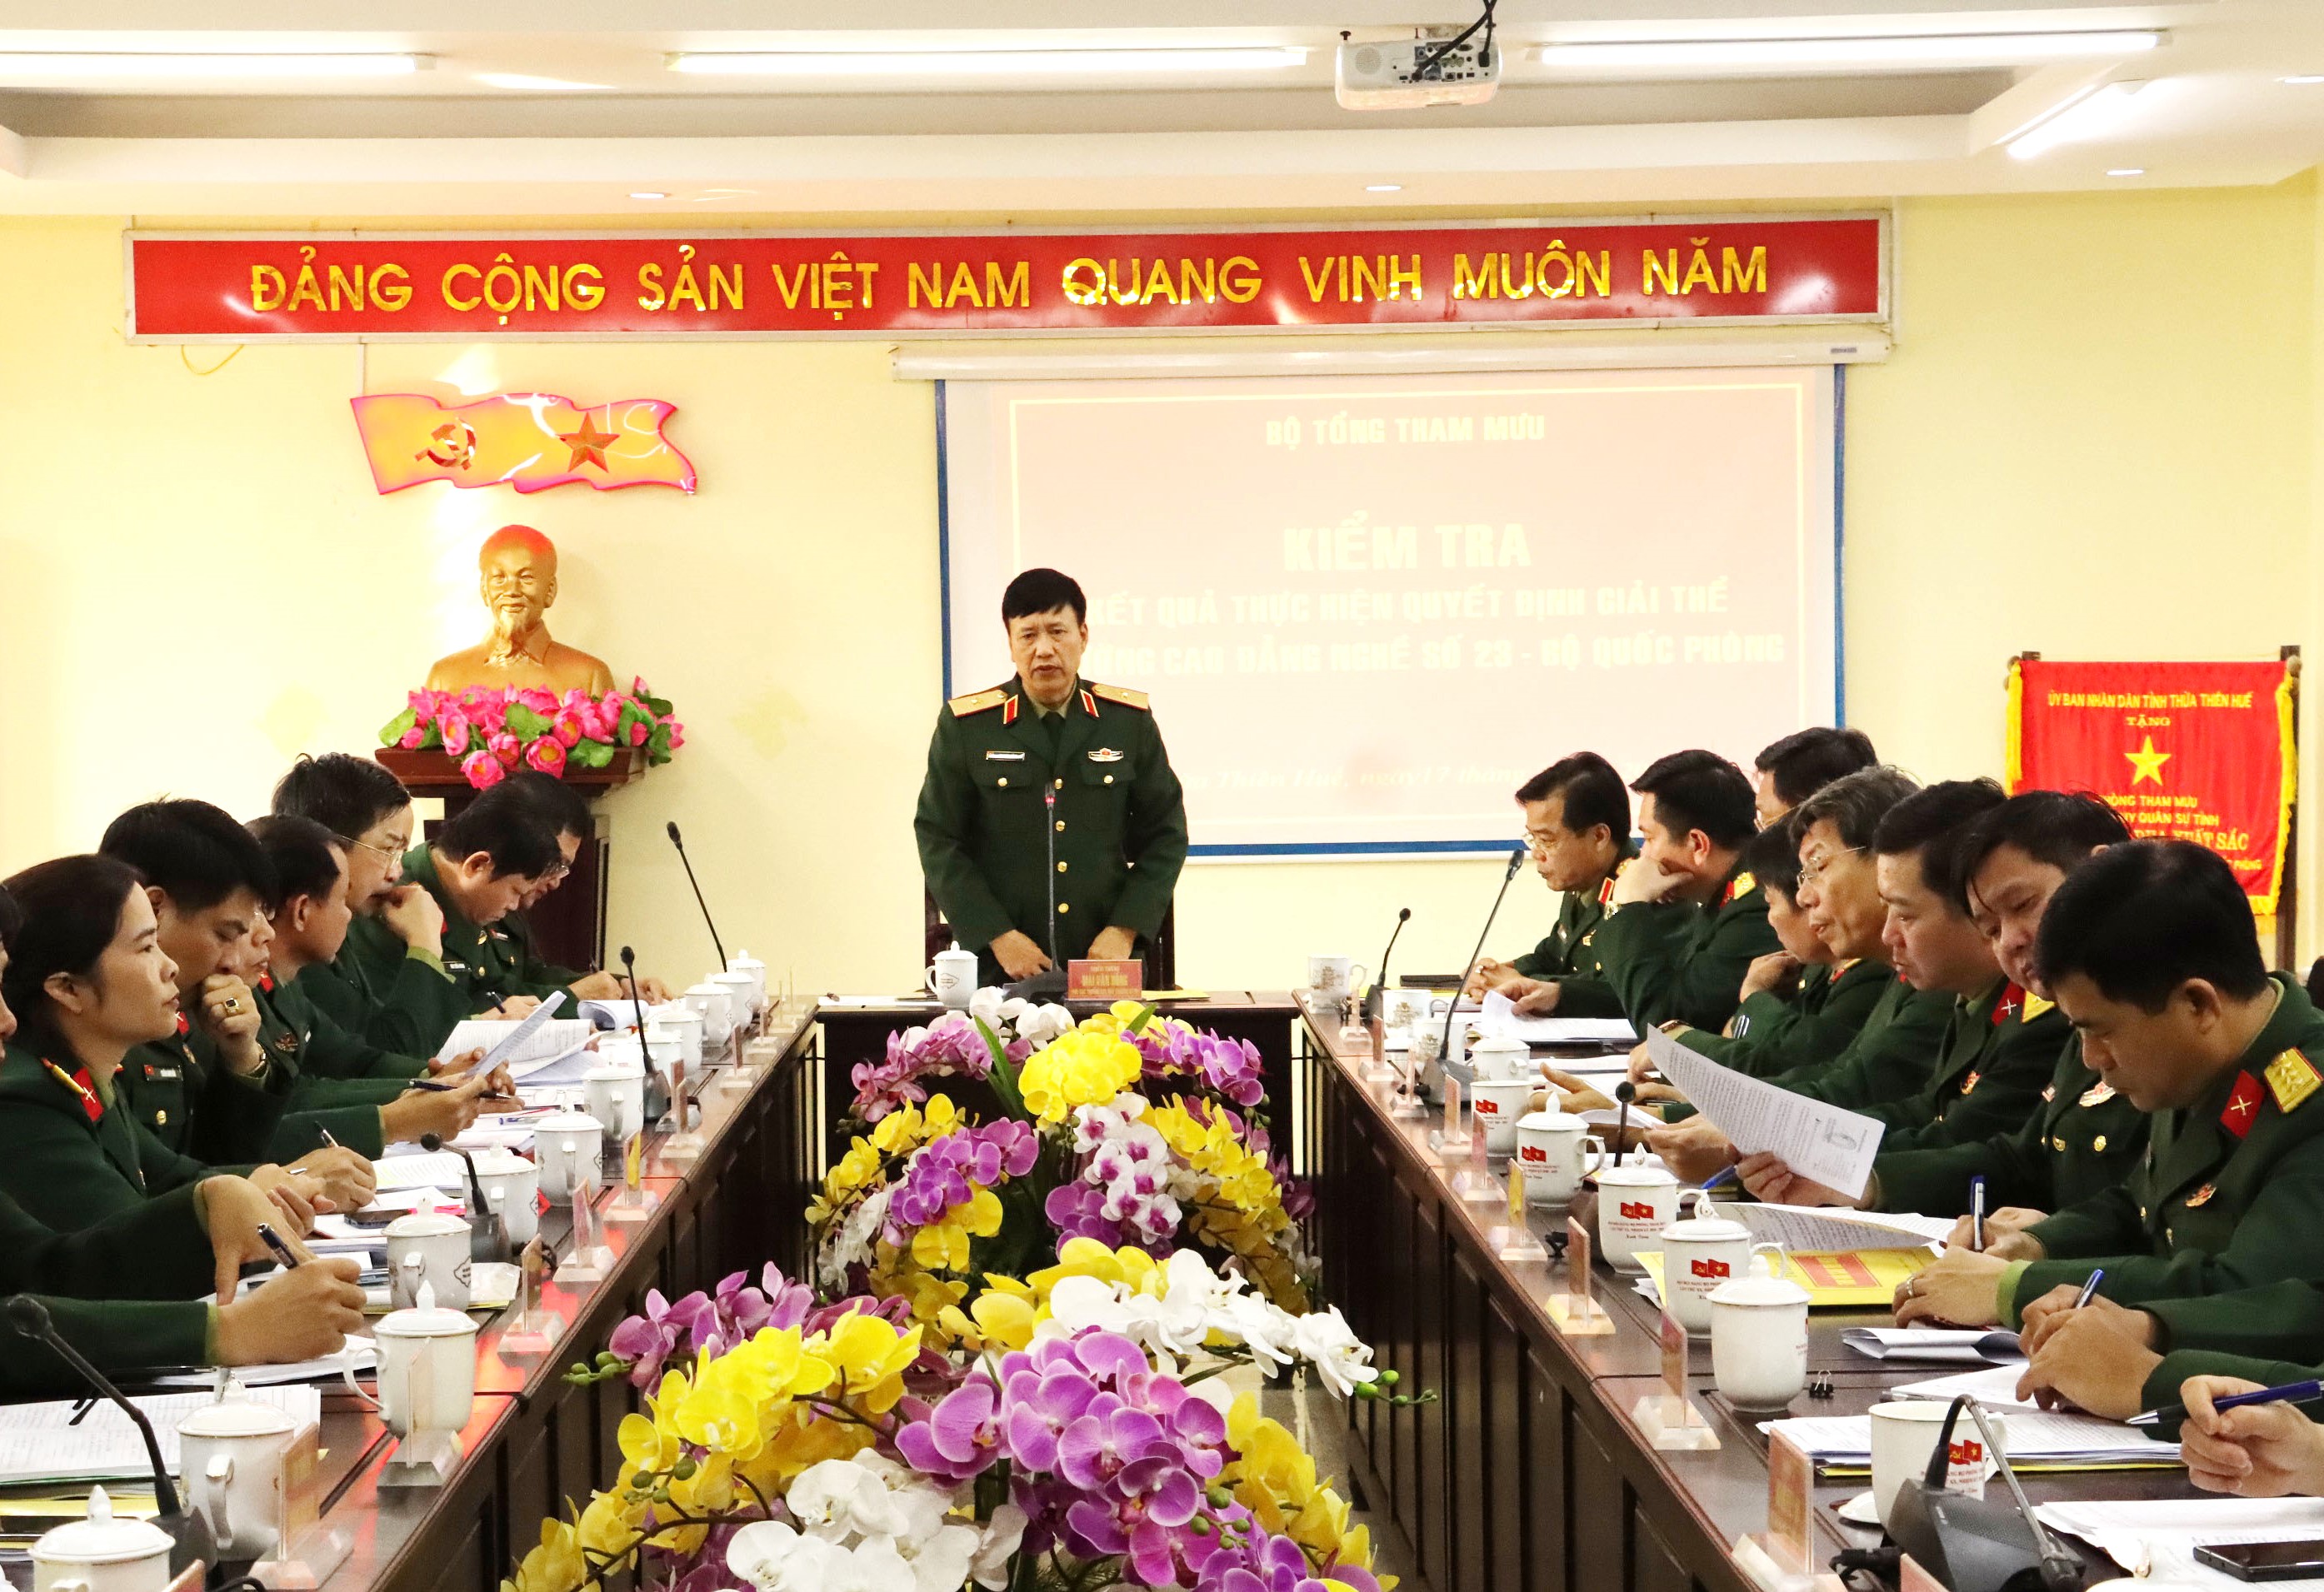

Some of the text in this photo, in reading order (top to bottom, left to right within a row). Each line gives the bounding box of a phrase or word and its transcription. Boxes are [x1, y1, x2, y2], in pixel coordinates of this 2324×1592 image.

[250, 237, 1767, 325] ĐẢNG CỘNG SẢN VIỆT NAM QUANG VINH MUÔN NĂM
[1266, 410, 1546, 450] BỘ TỔNG THAM MƯU
[1283, 509, 1532, 571] KIỂM TRA
[1087, 590, 1146, 626] KẾT
[1157, 589, 1218, 627] QUẢ
[1231, 591, 1310, 626] THỰC
[1319, 587, 1393, 626] HIỆN
[1402, 582, 1503, 623] QUYẾT
[1515, 587, 1585, 621] ĐỊNH
[1597, 579, 1659, 616] GIẢI
[1163, 645, 1224, 676] CAO
[1422, 632, 1464, 669] SỐ
[1473, 638, 1512, 668] 23
[1542, 632, 1581, 671] BỘ
[1592, 629, 1674, 669] QUỐC
[1683, 630, 1785, 664] PHÒNG
[2062, 692, 2086, 707] BAN
[2117, 691, 2141, 709] DÂN
[2140, 795, 2172, 807] THAM
